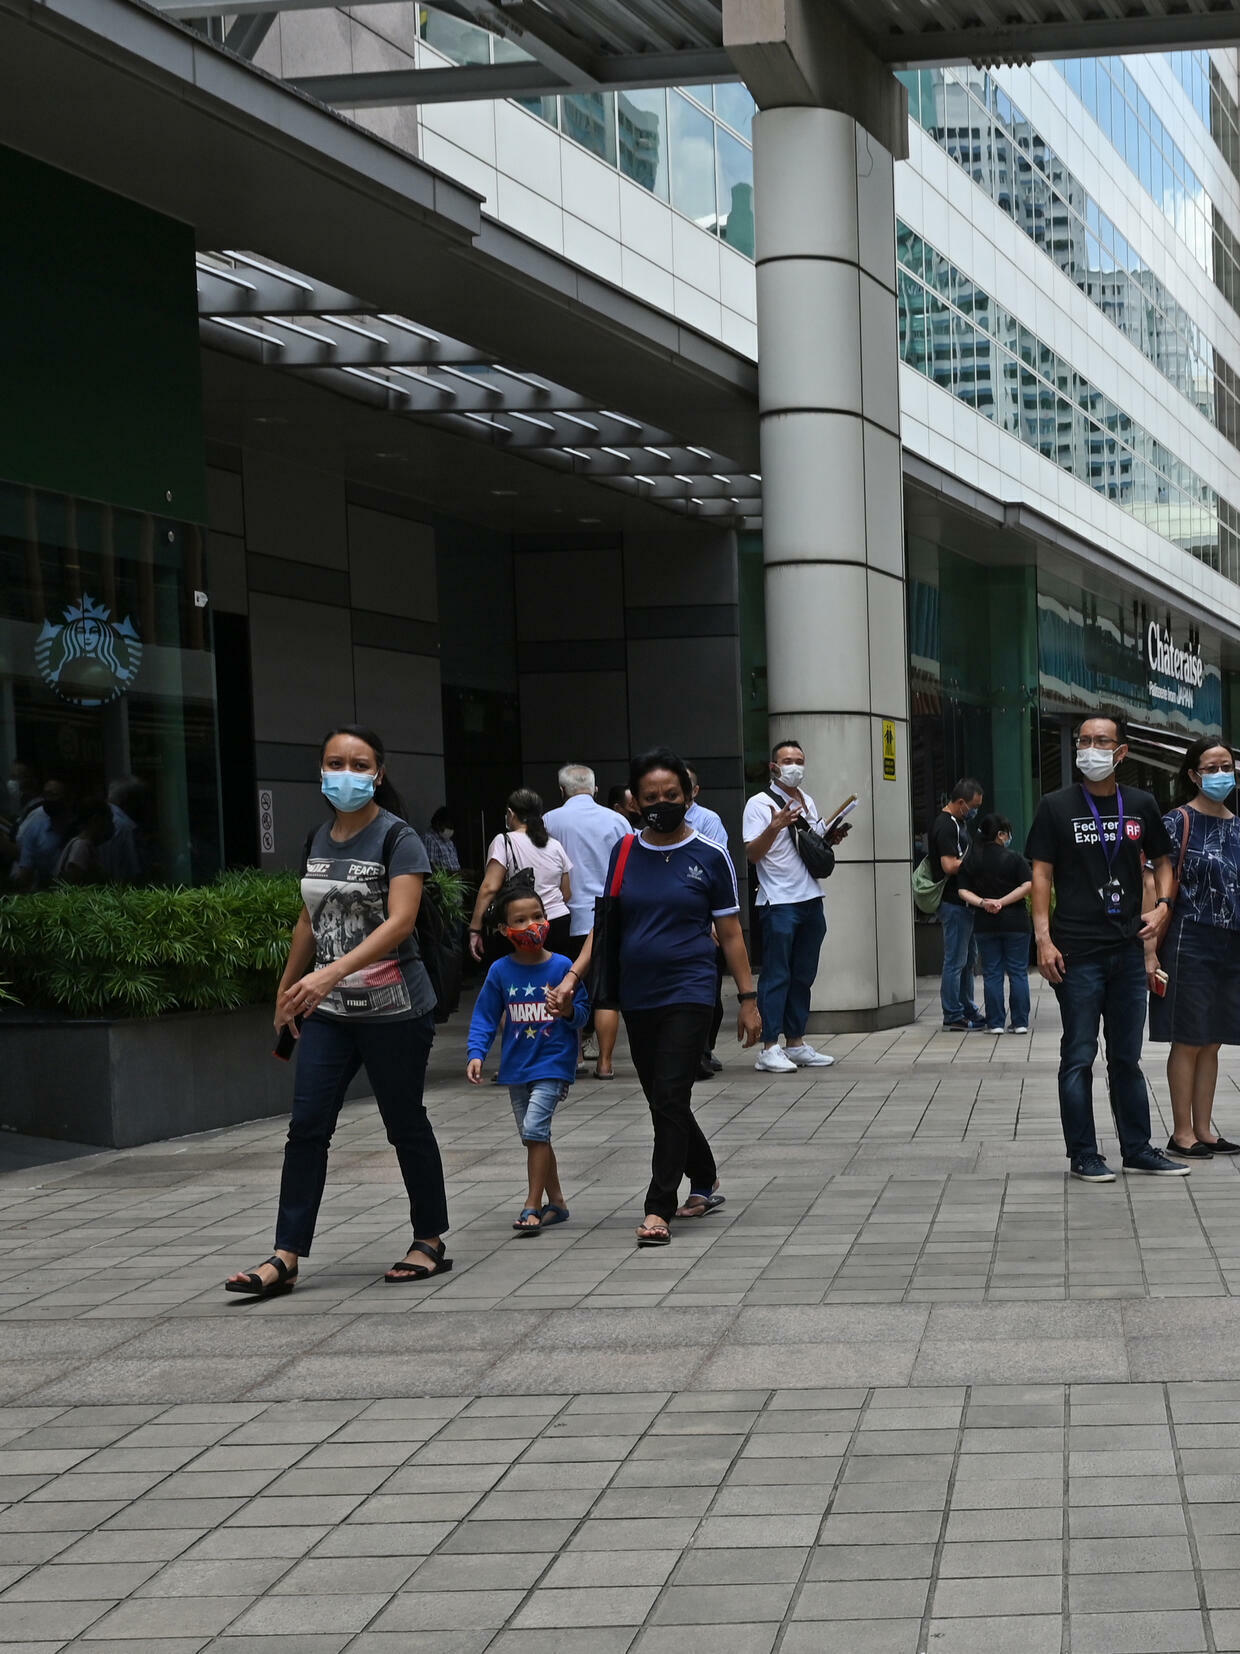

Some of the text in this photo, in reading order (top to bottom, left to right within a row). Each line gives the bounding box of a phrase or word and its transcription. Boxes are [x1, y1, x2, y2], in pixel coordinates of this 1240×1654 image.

[1148, 621, 1203, 688] Châteraisé
[1073, 820, 1119, 832] Fedrer
[1126, 825, 1140, 836] RF
[1075, 832, 1123, 844] Expes
[508, 1003, 554, 1022] MARVE
